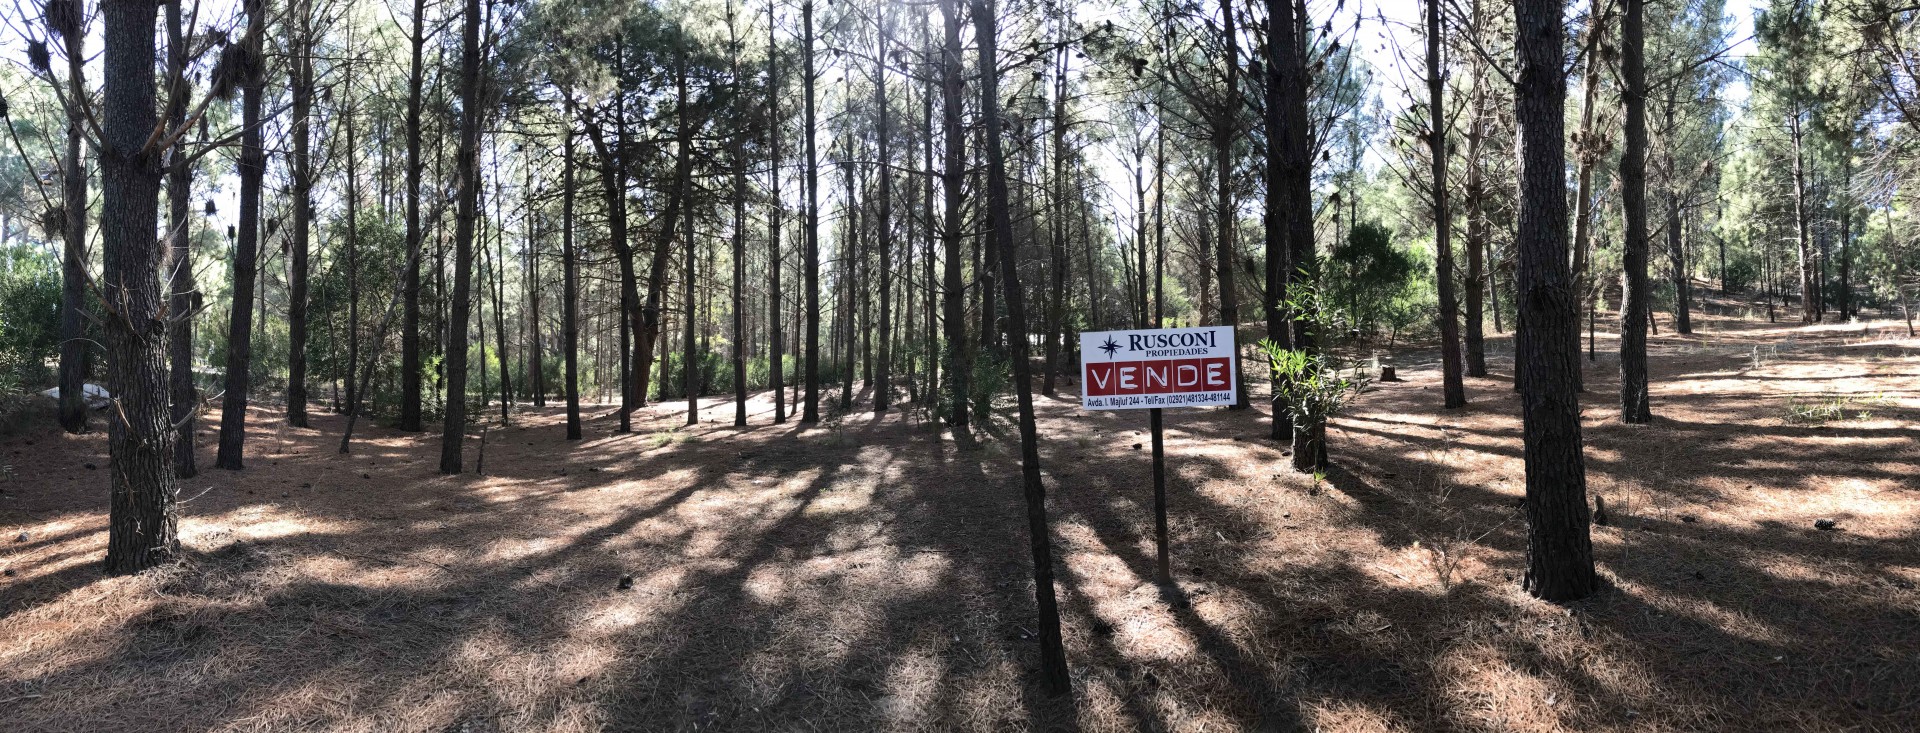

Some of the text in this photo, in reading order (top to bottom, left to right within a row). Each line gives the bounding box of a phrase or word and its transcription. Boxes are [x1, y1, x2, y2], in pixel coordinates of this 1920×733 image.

[1128, 331, 1216, 351] RUSCONI
[1145, 347, 1208, 357] PROPIEDADES
[1091, 363, 1225, 389] VENDE
[1087, 398, 1104, 407] Avda.
[1129, 396, 1140, 406] 244
